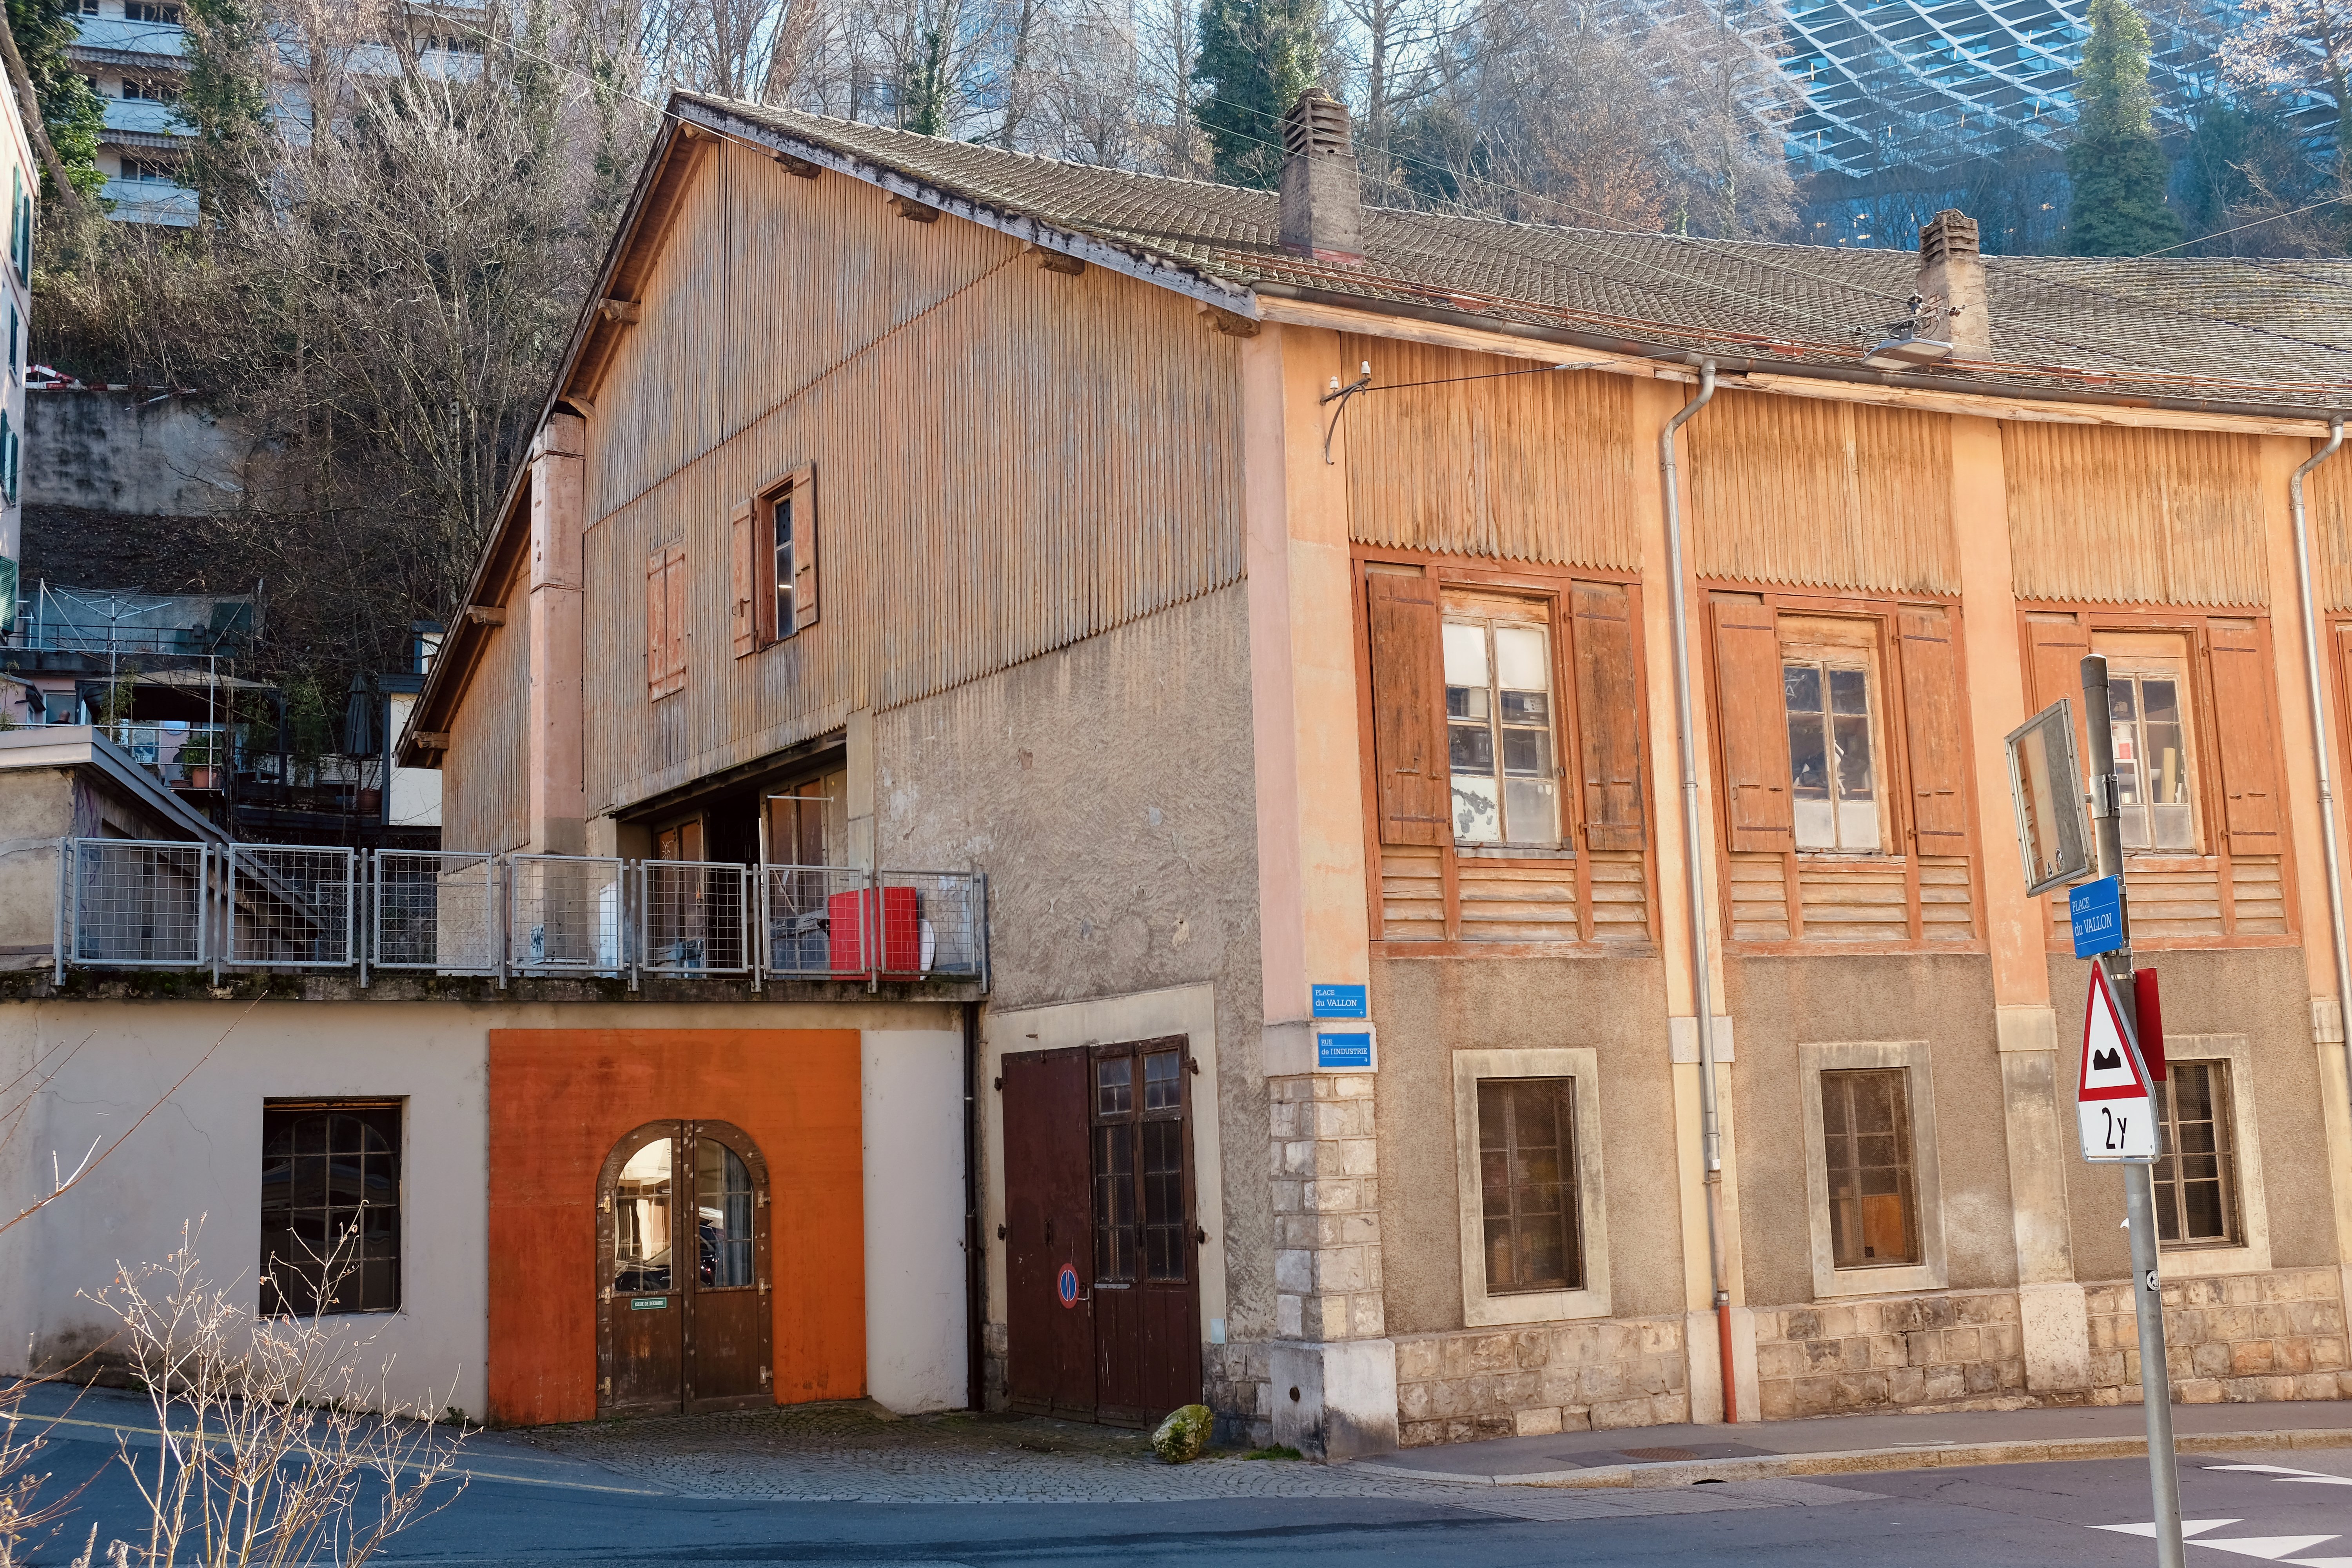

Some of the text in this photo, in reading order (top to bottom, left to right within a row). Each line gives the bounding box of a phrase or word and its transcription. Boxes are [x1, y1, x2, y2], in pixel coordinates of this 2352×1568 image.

[2072, 897, 2090, 912] PLACE
[2075, 913, 2112, 936] du VALLON
